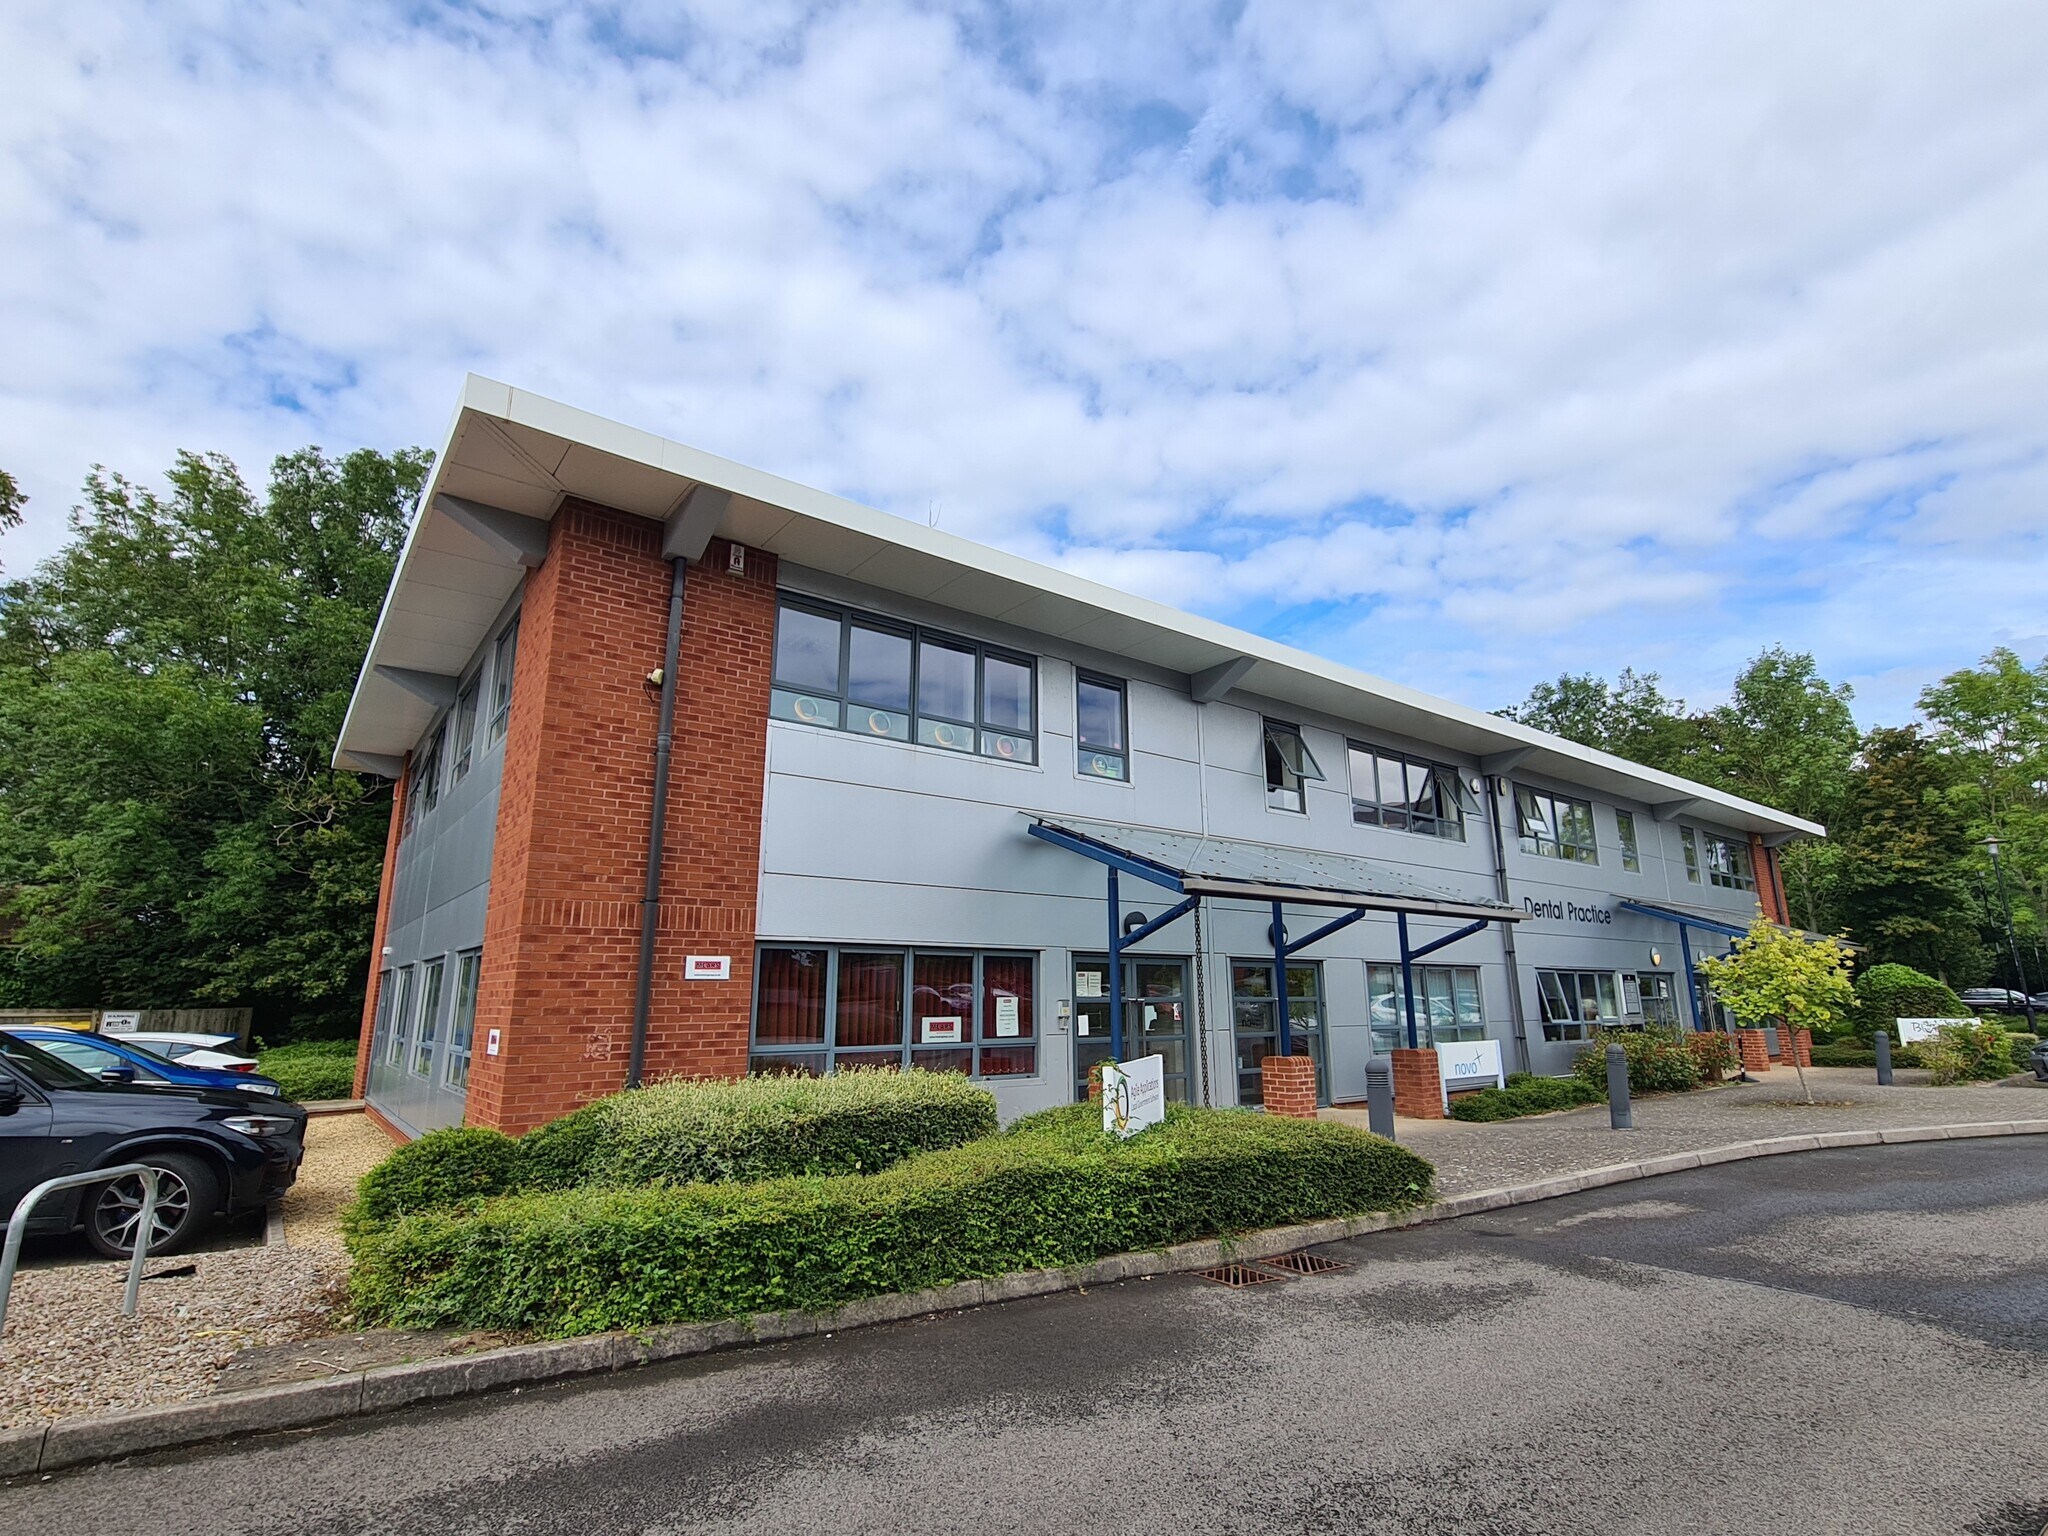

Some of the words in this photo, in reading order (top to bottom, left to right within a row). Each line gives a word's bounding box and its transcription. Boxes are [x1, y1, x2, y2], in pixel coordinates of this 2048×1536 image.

[1523, 897, 1563, 920] Dental
[1567, 902, 1611, 925] Practice
[1454, 1061, 1478, 1076] novo
